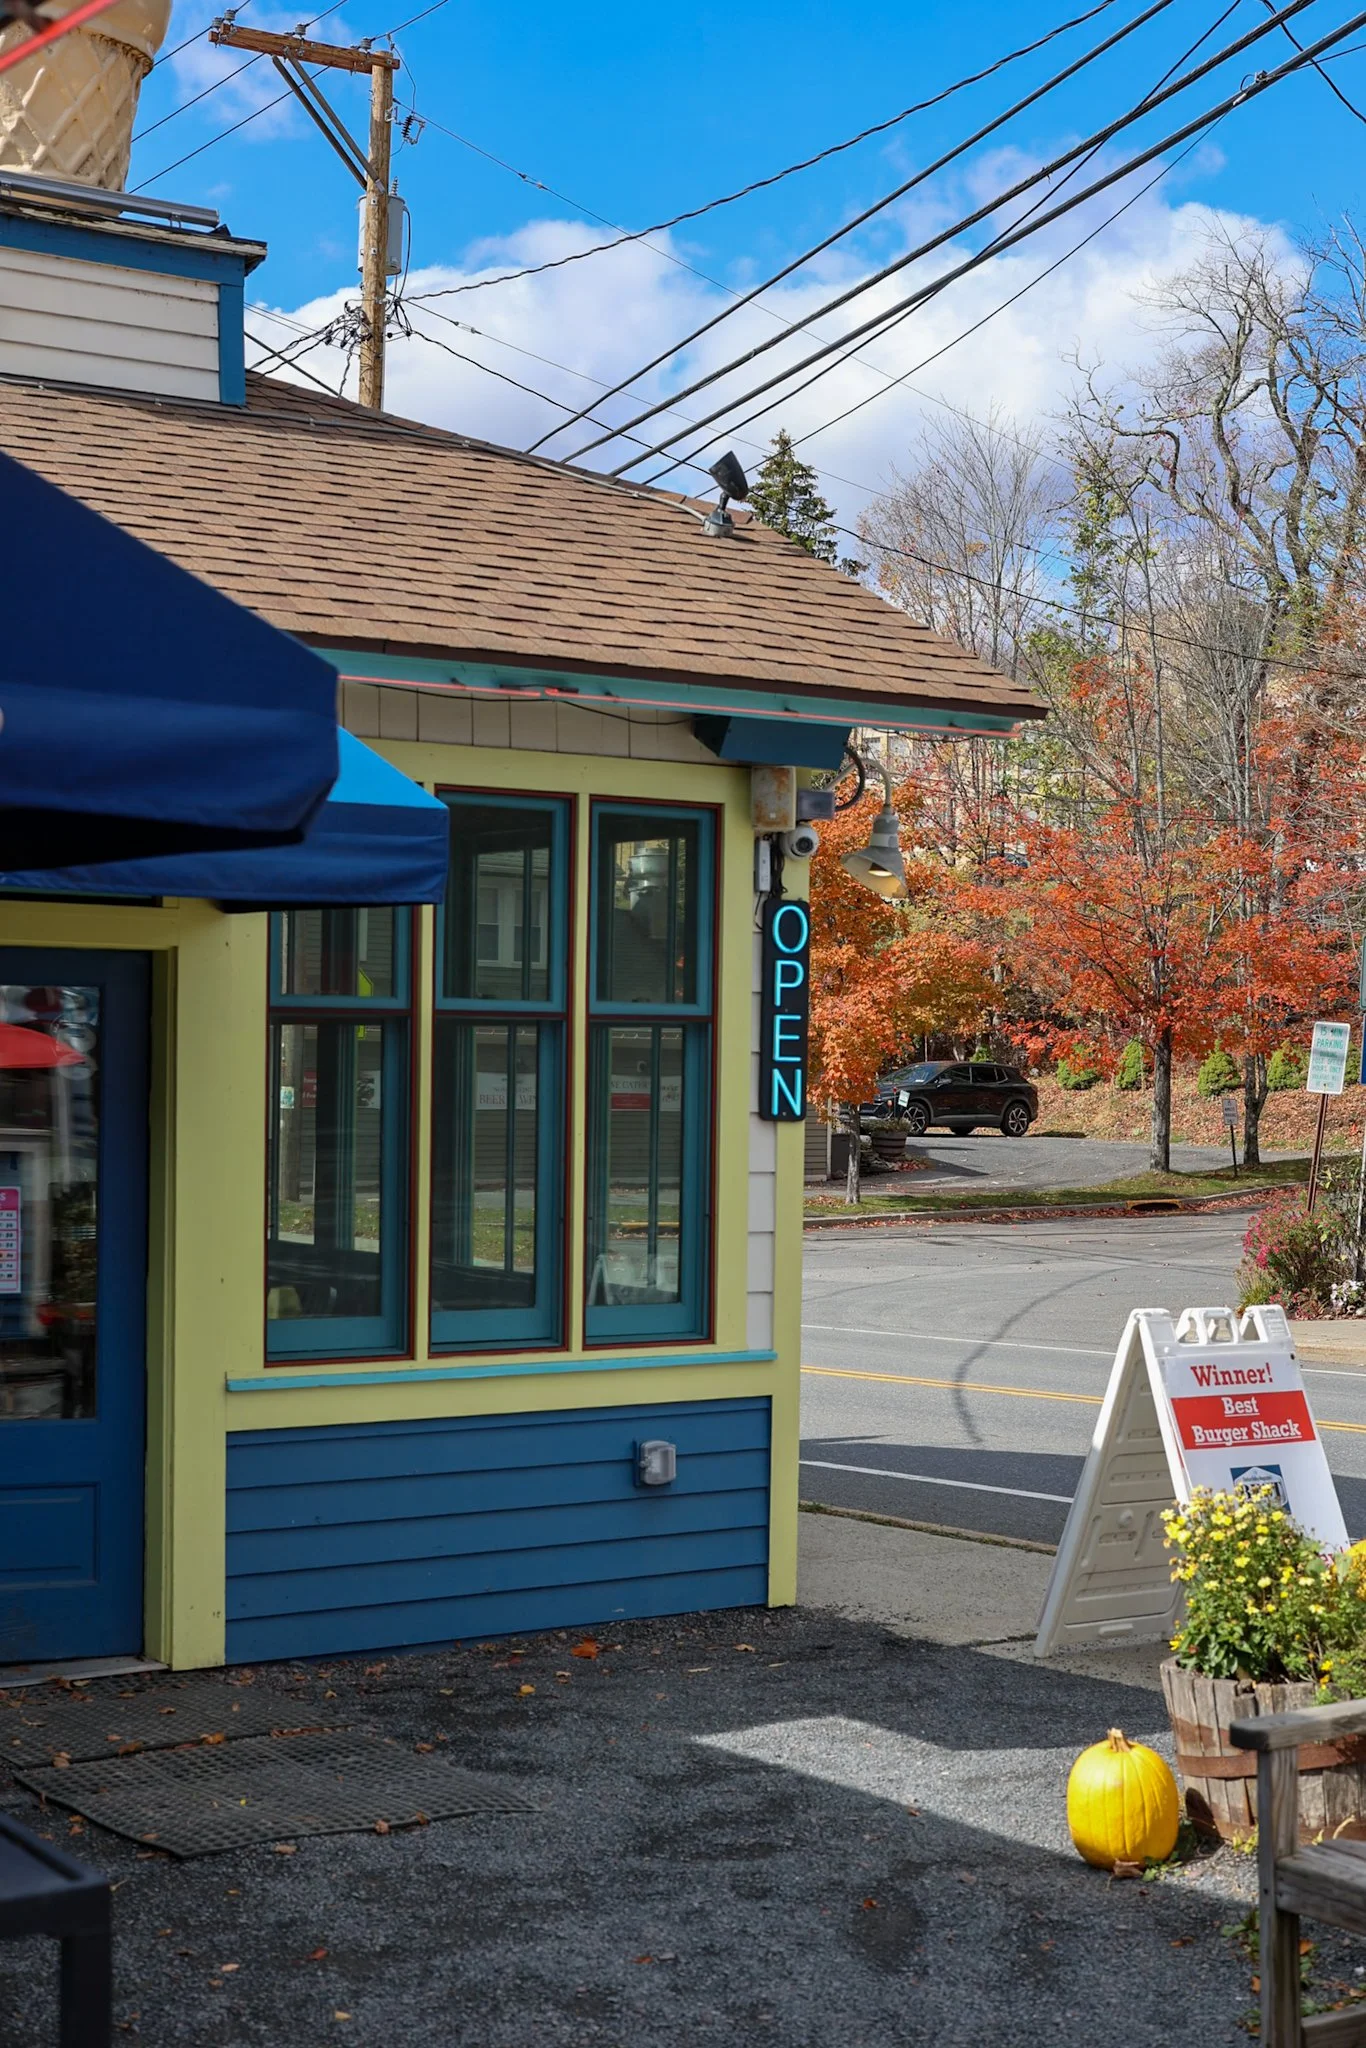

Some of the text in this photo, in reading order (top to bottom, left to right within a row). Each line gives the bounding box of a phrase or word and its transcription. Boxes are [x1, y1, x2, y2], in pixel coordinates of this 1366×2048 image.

[771, 904, 809, 1117] OPEN
[1320, 1027, 1327, 1036] 15
[1316, 1038, 1344, 1049] PARKING
[1190, 1362, 1273, 1387] Winner!
[1221, 1397, 1259, 1415] Best
[1191, 1419, 1302, 1446] Burger Shack
